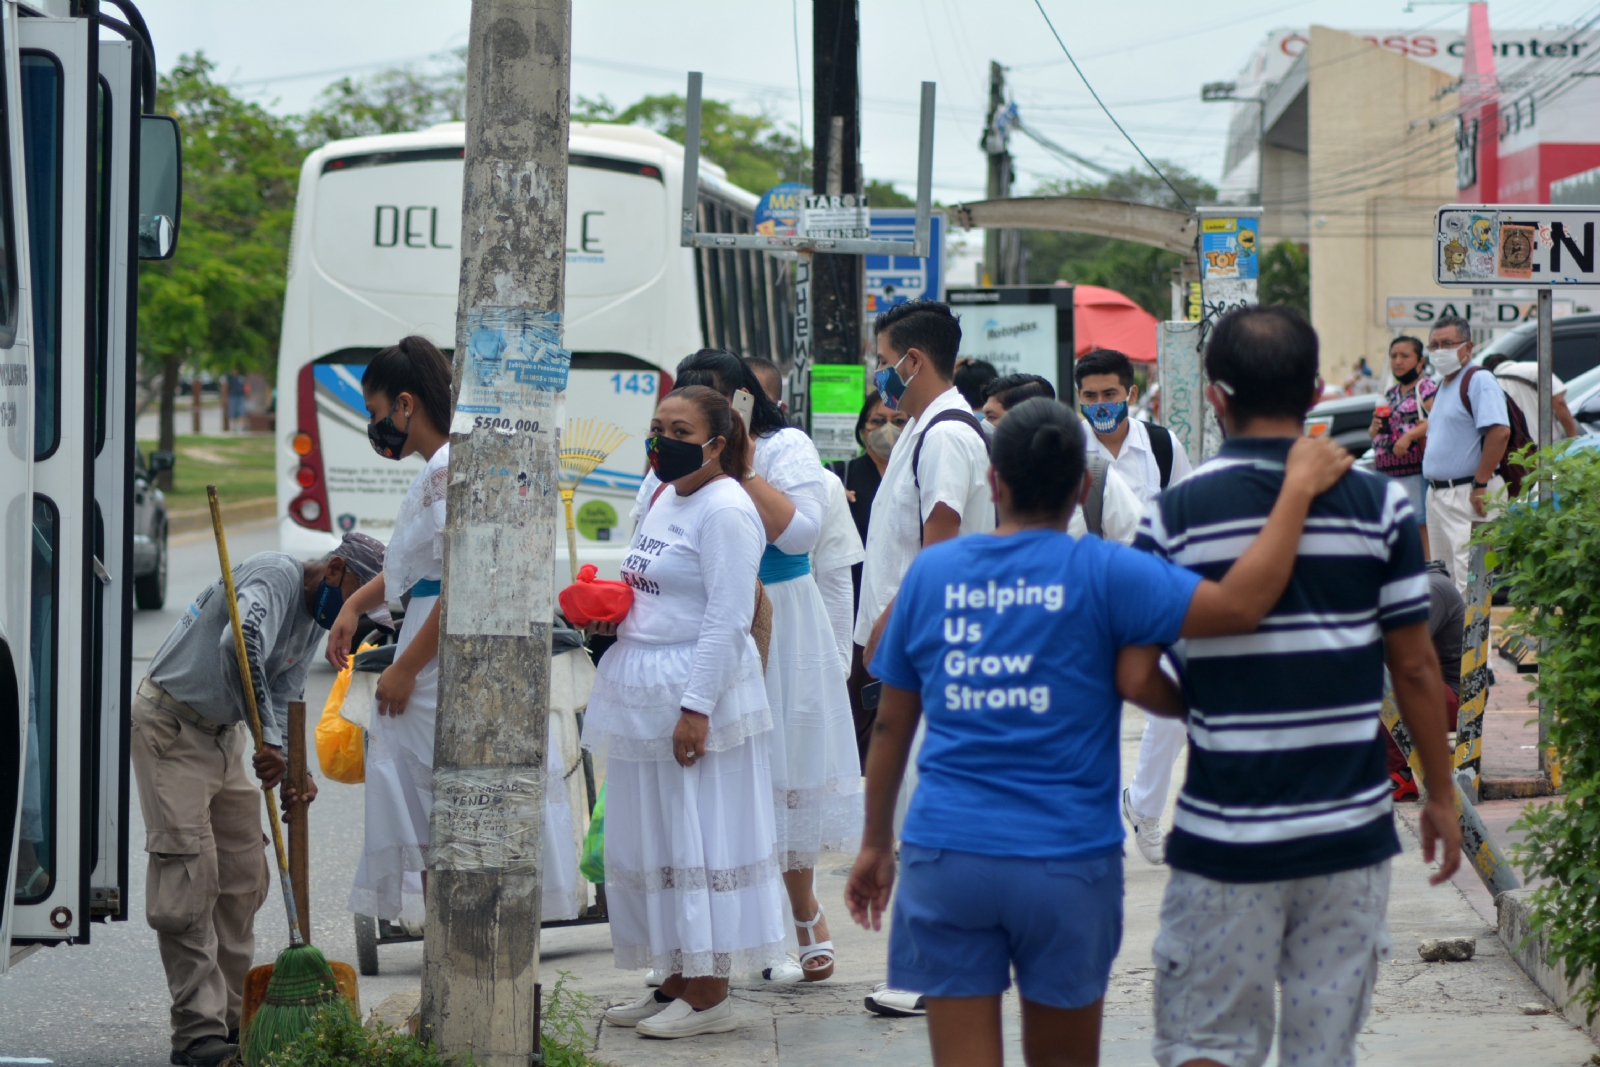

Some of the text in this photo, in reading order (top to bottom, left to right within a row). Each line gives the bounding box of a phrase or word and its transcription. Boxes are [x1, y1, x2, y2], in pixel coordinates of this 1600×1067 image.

[806, 194, 867, 209] TAROT
[374, 205, 453, 249] DEL
[1205, 251, 1237, 268] TOY
[986, 321, 1038, 340] Rotoplas
[610, 373, 655, 395] 143
[474, 415, 539, 433] $500,000
[622, 554, 652, 574] NEW
[945, 578, 1064, 614] Helping
[944, 617, 982, 643] Us
[944, 650, 1033, 676] Grow
[944, 683, 1049, 713] Strong
[452, 794, 503, 806] VENDO
